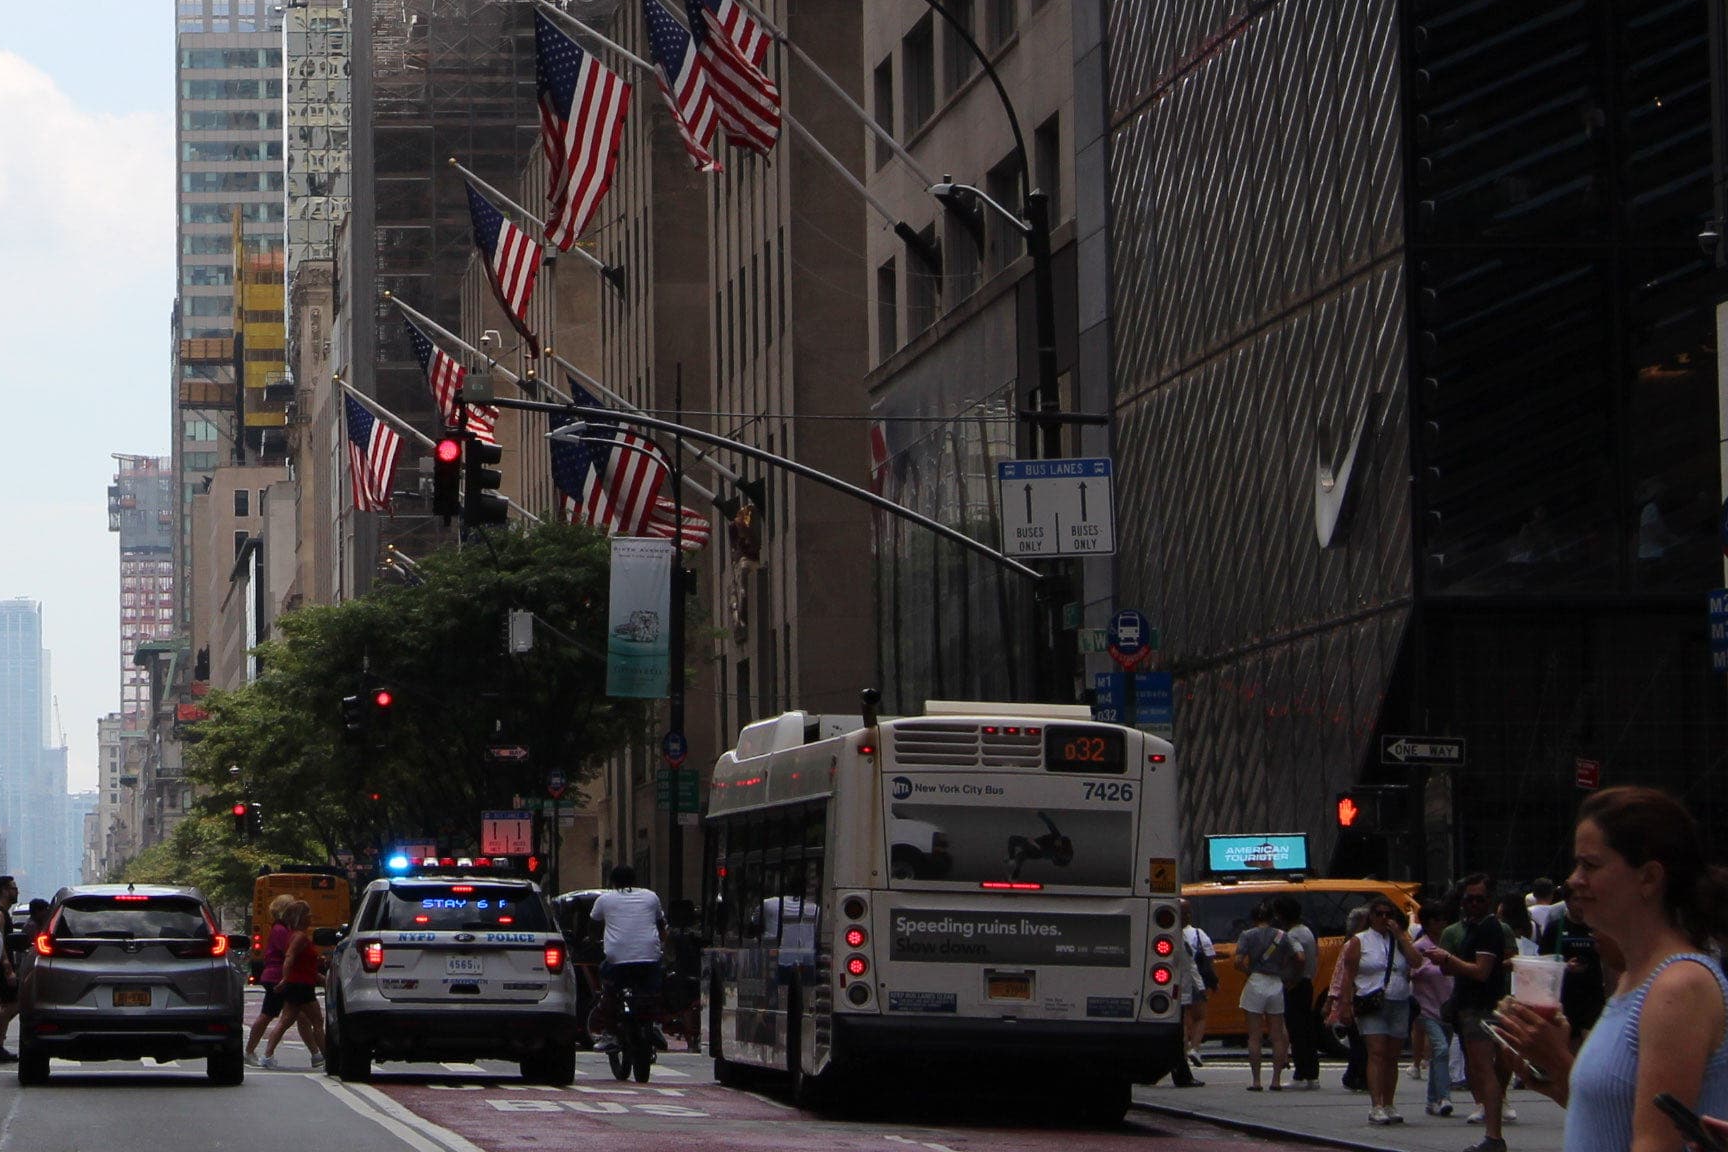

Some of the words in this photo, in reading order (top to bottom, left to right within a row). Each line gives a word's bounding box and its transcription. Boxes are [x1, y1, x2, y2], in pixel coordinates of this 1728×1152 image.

[1026, 464, 1046, 476] BUS
[1050, 463, 1084, 474] LANES
[1017, 527, 1044, 538] BUSES
[1072, 525, 1099, 536] BUSES
[1020, 541, 1042, 551] ONLY
[1074, 539, 1097, 549] ONLY
[1394, 745, 1418, 756] ONE
[1430, 746, 1454, 756] WAY
[915, 784, 937, 793] New
[939, 783, 960, 794] York
[963, 784, 982, 795] City
[985, 785, 1004, 795] Bus
[1083, 782, 1133, 802] 7426
[1225, 846, 1289, 854] AMERICAN
[1225, 854, 1288, 862] TOURISTER
[422, 899, 467, 909] STAY
[477, 900, 488, 909] 6
[896, 917, 974, 938] Speeding
[977, 919, 1017, 935] ruins
[1021, 920, 1062, 936] lives.
[398, 933, 436, 942] NYPD
[487, 934, 536, 943] POLICE
[896, 938, 936, 953] Slow
[449, 959, 472, 969] 4565
[485, 1099, 710, 1117] BUS
